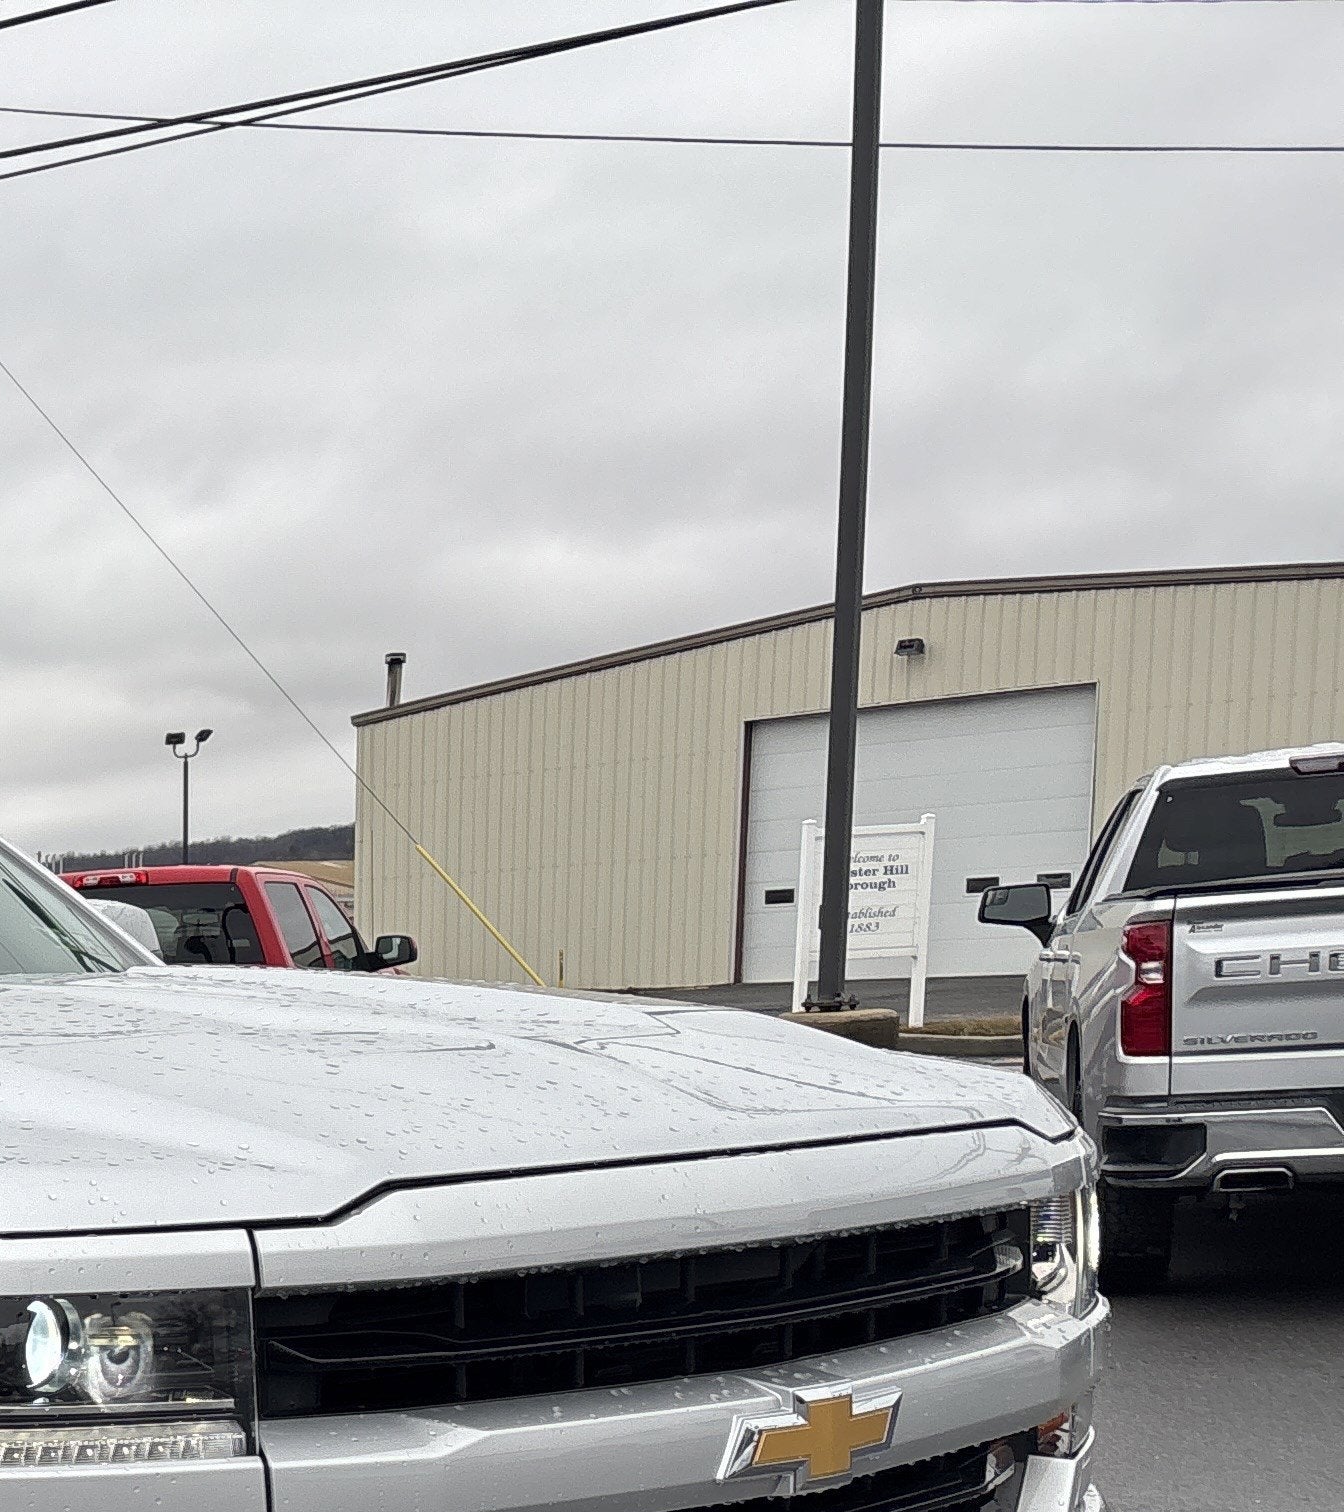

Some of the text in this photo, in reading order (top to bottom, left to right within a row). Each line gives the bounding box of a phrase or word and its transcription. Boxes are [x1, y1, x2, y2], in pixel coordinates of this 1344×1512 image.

[887, 853, 900, 863] to
[882, 864, 909, 876] Hill
[848, 878, 896, 891] orough
[849, 921, 880, 934] 1883
[1183, 1031, 1319, 1046] SILVERADO
